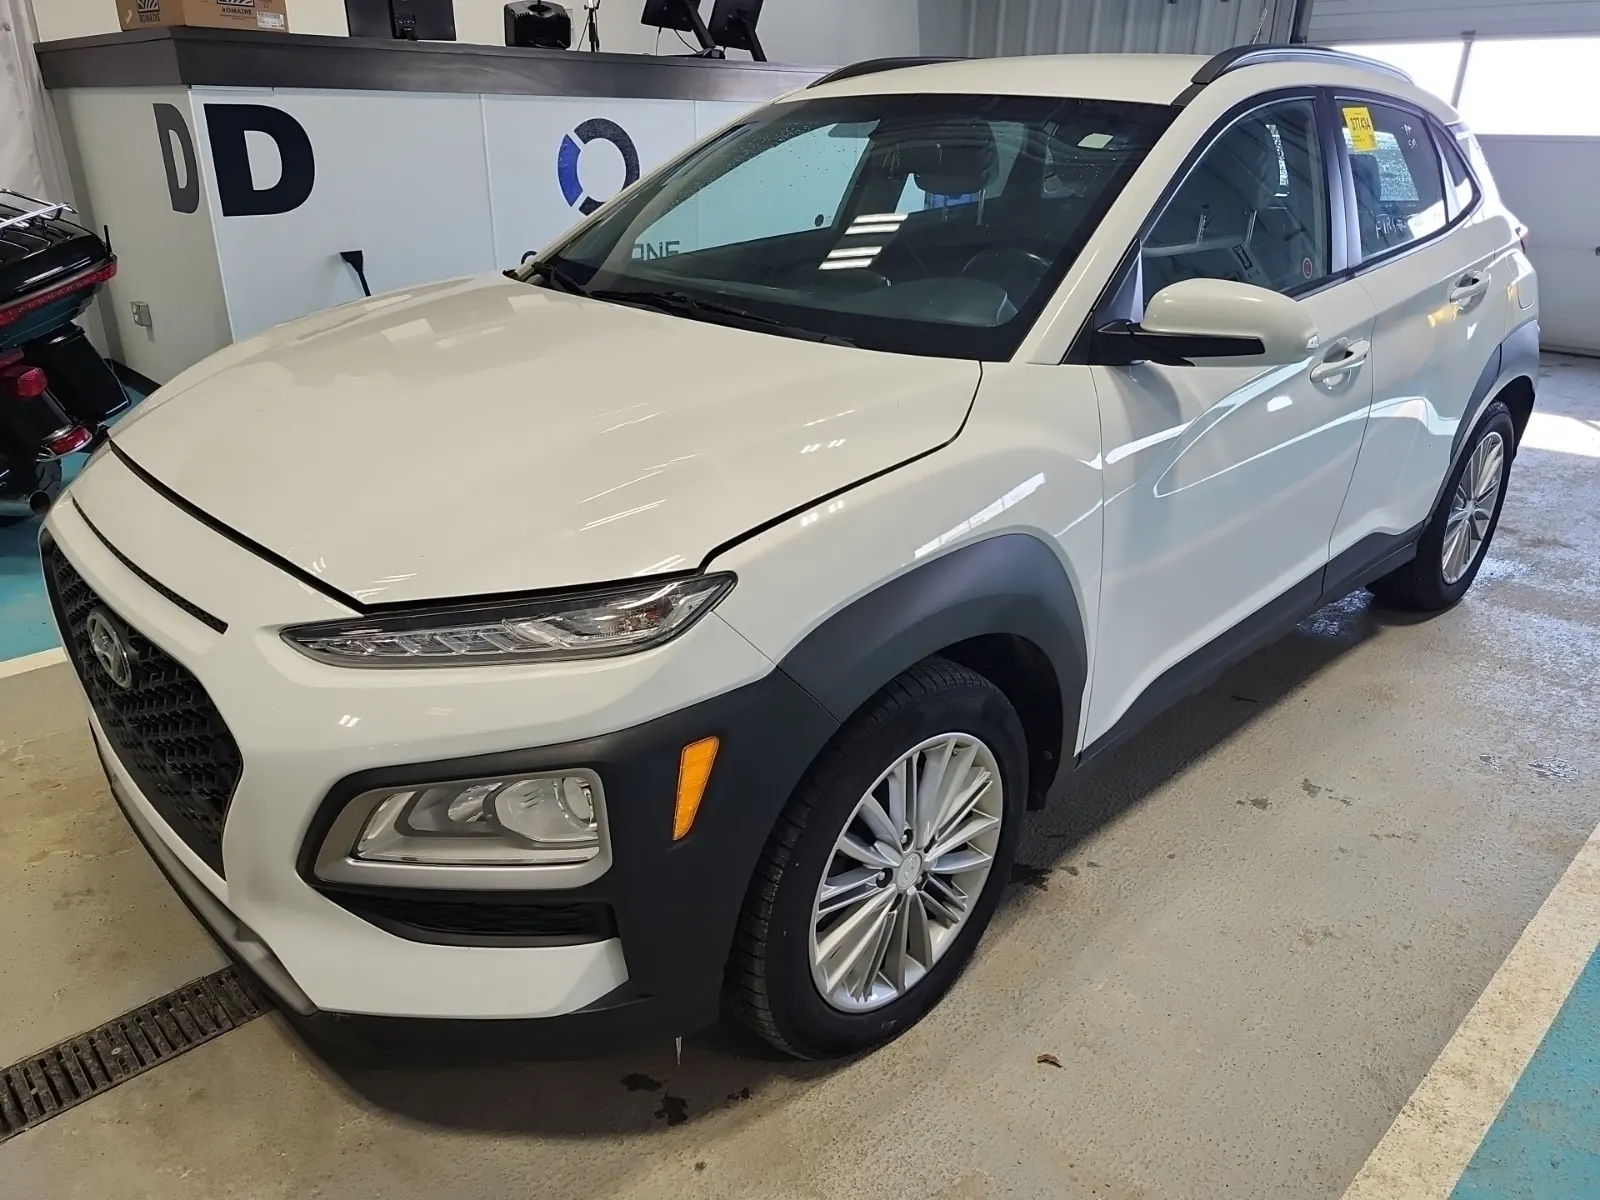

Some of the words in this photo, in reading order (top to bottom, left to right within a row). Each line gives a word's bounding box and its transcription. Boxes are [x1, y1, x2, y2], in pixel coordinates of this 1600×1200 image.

[221, 7, 253, 15] ROMAINE
[152, 102, 200, 214] D
[203, 103, 315, 217] D
